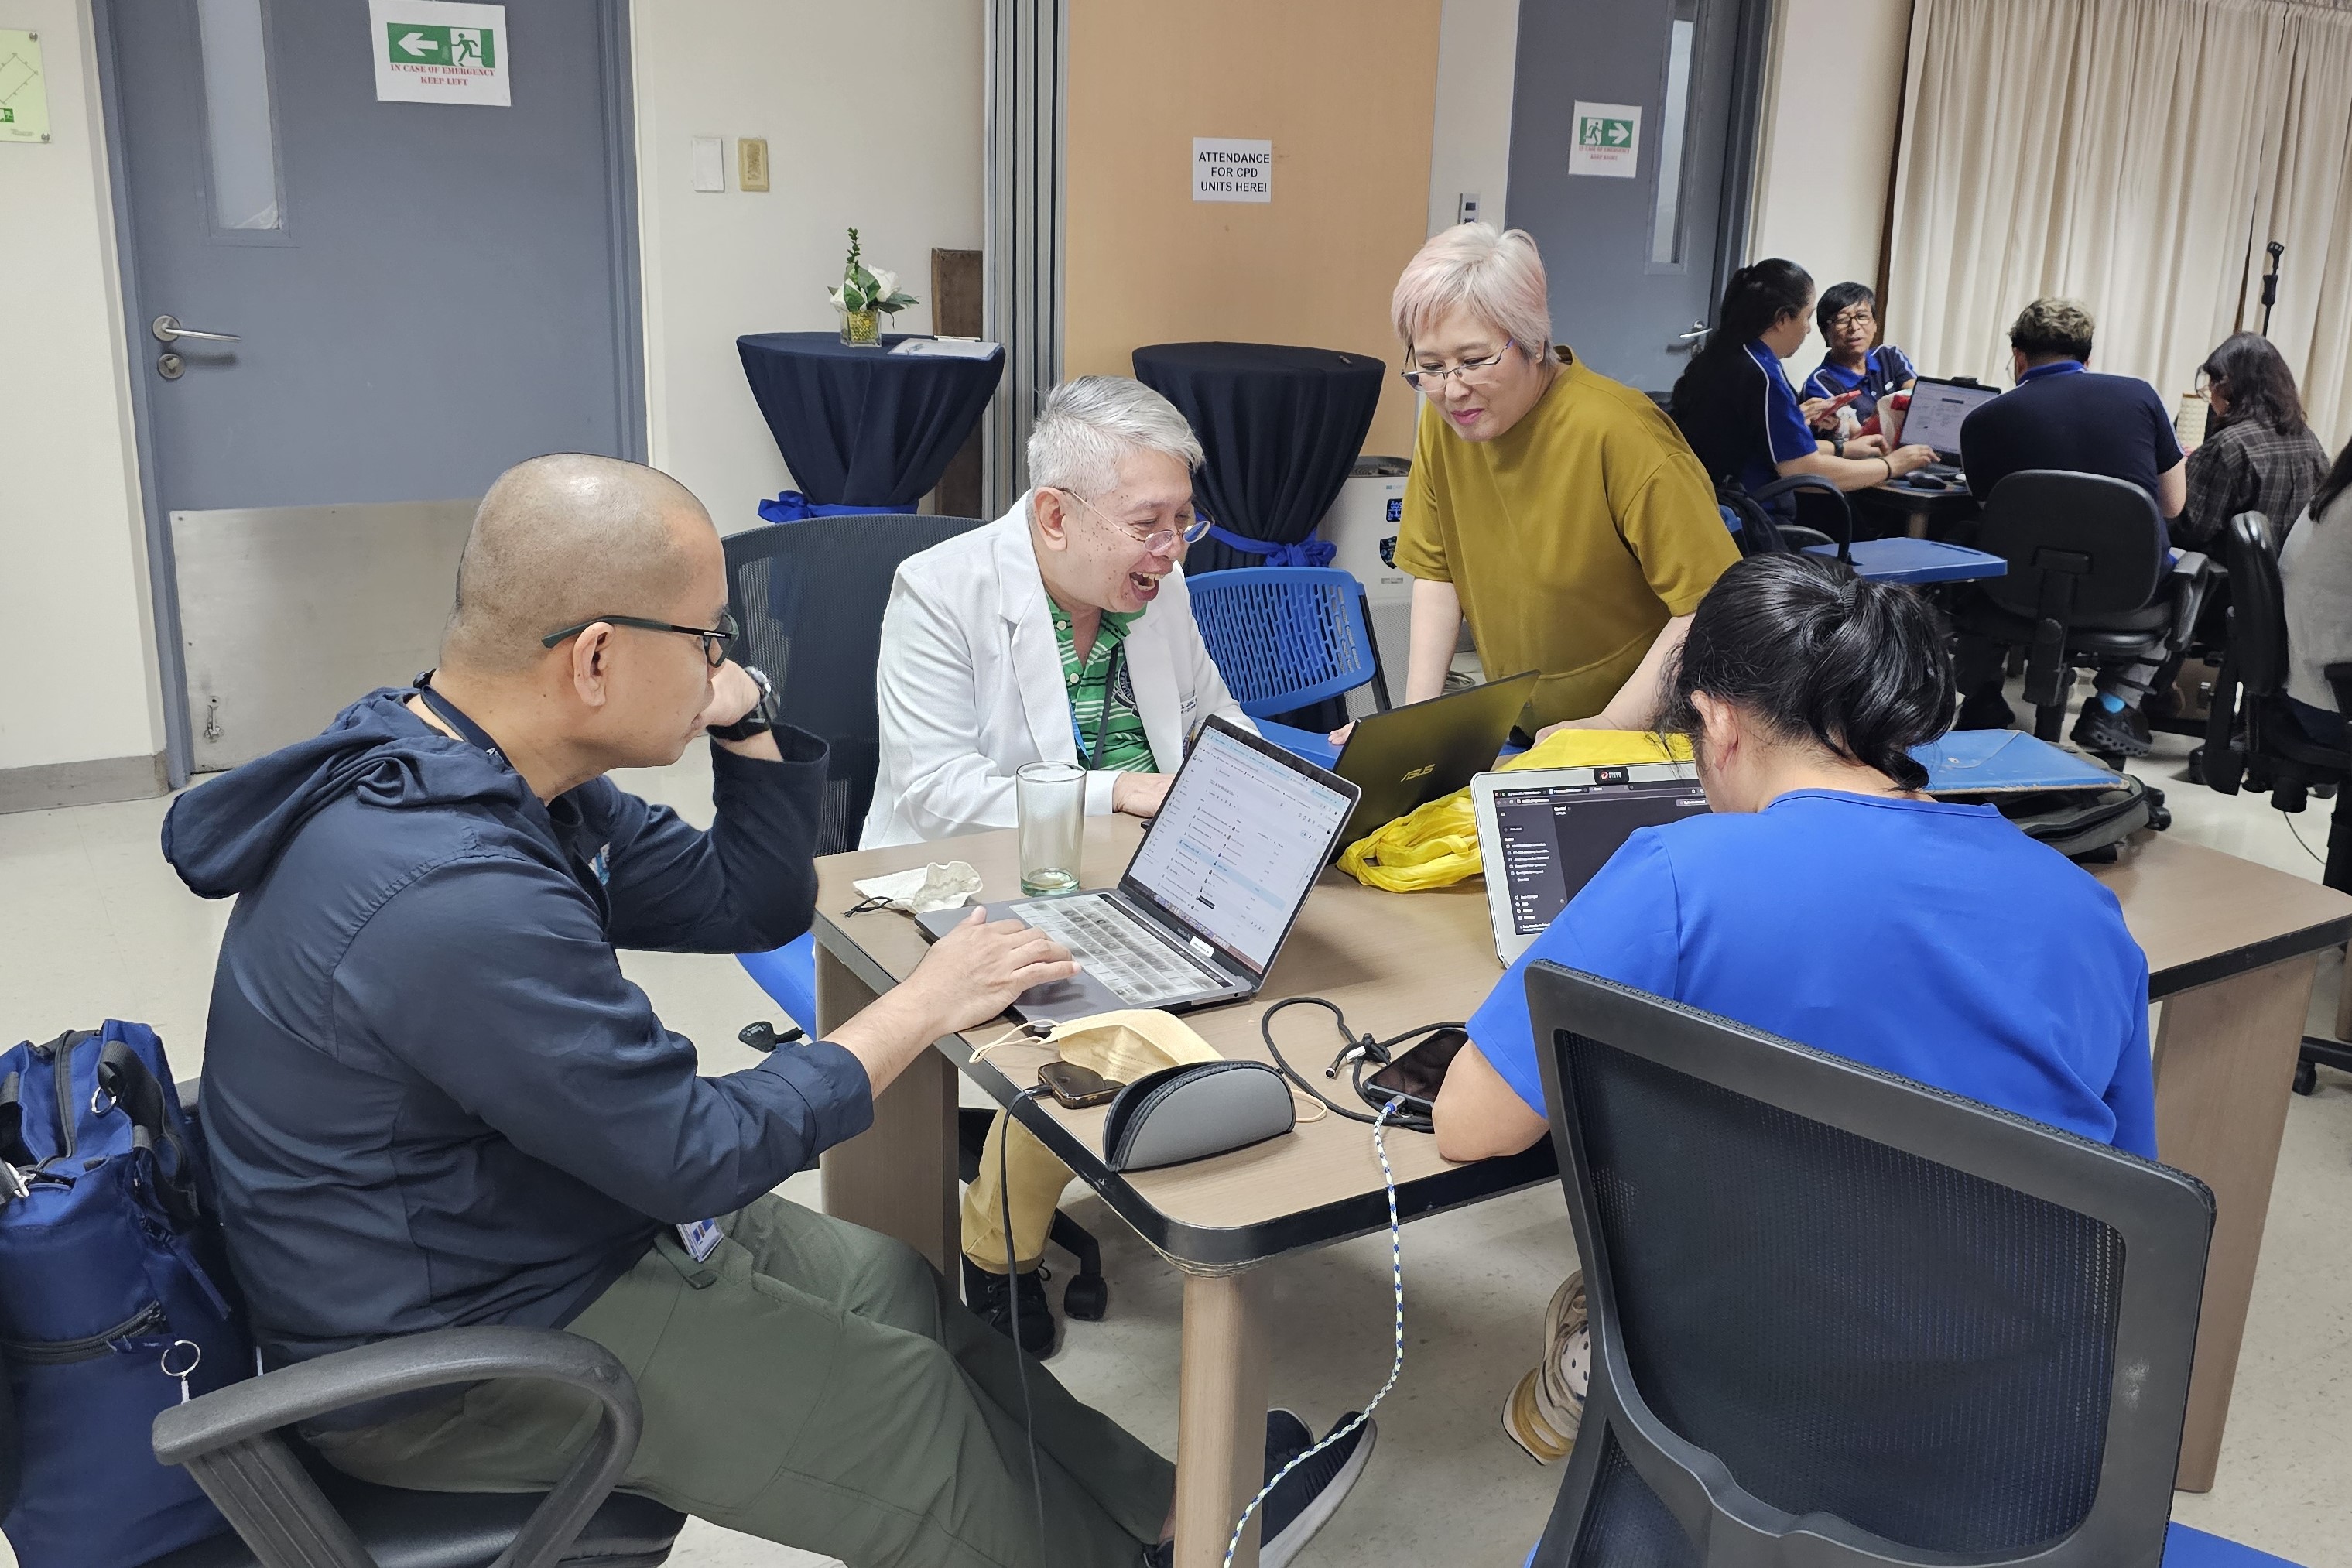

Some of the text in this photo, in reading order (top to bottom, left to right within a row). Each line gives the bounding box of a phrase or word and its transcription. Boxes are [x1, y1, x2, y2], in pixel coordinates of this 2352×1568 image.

[443, 67, 495, 77] EMERGENCY
[421, 77, 468, 86] KEEP LEFT
[1199, 152, 1269, 164] ATTENDANCE
[1211, 167, 1258, 178] FOR CPD
[1201, 181, 1267, 193] UNITS HERE!
[1400, 763, 1436, 782] ASUS
